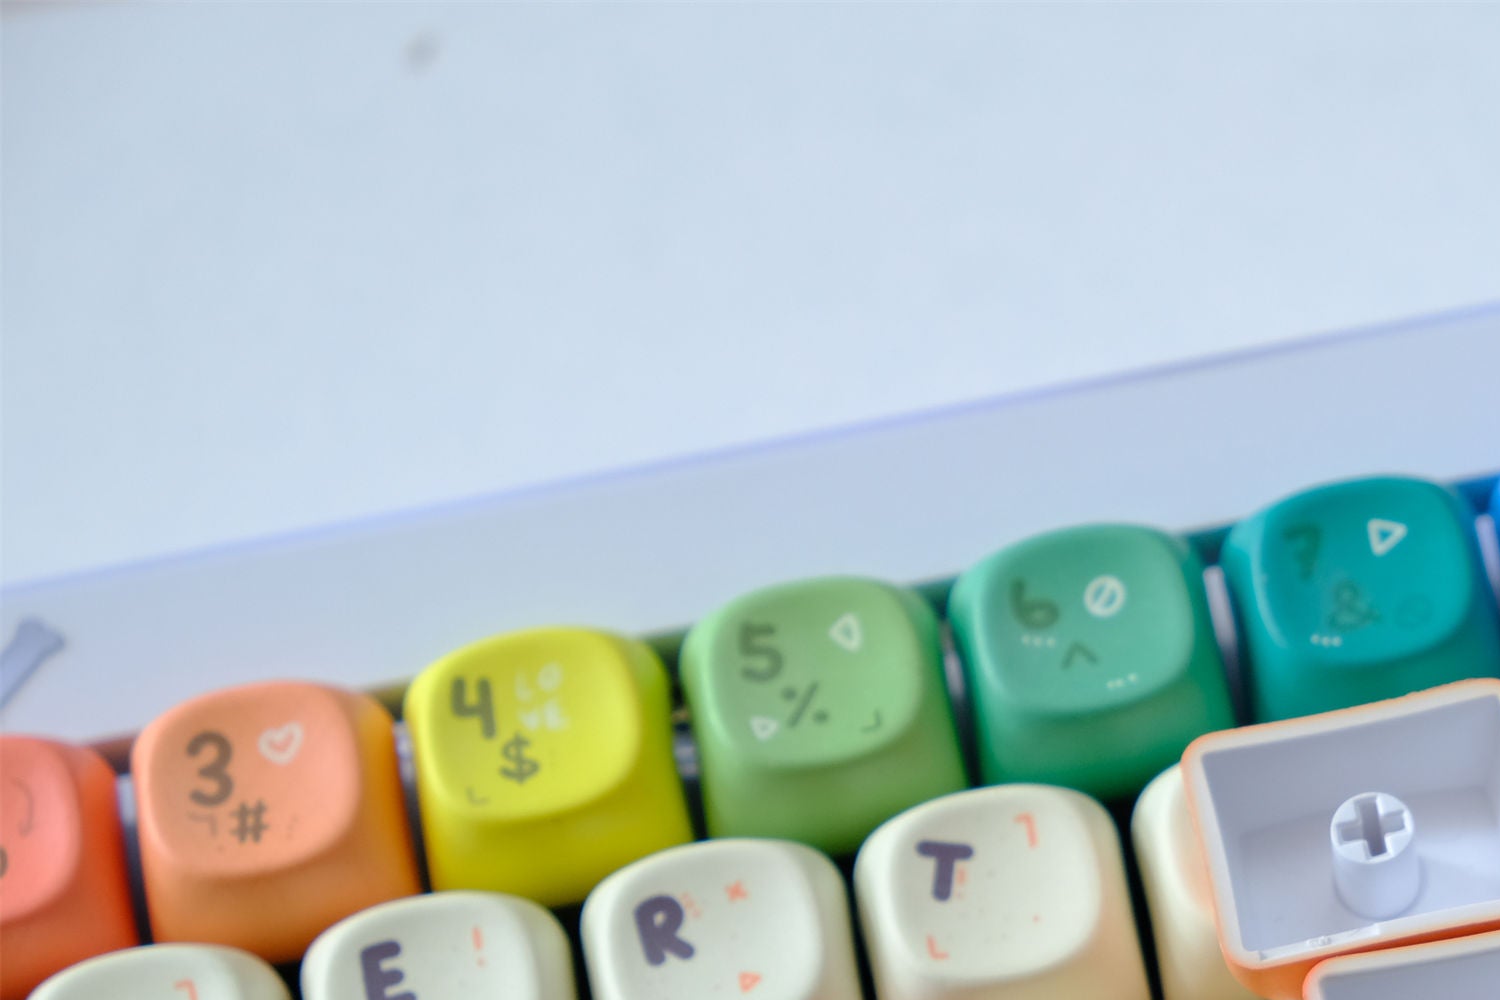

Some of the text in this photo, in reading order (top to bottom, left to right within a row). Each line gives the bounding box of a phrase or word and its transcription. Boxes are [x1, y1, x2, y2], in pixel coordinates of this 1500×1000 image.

[1010, 578, 1060, 633] 6
[738, 621, 785, 683] 5
[451, 674, 498, 741] 4
[780, 680, 829, 730] %
[185, 730, 235, 808] 3
[499, 730, 541, 786] $
[228, 801, 271, 845] #
[916, 839, 975, 903] T
[634, 894, 696, 967] R
